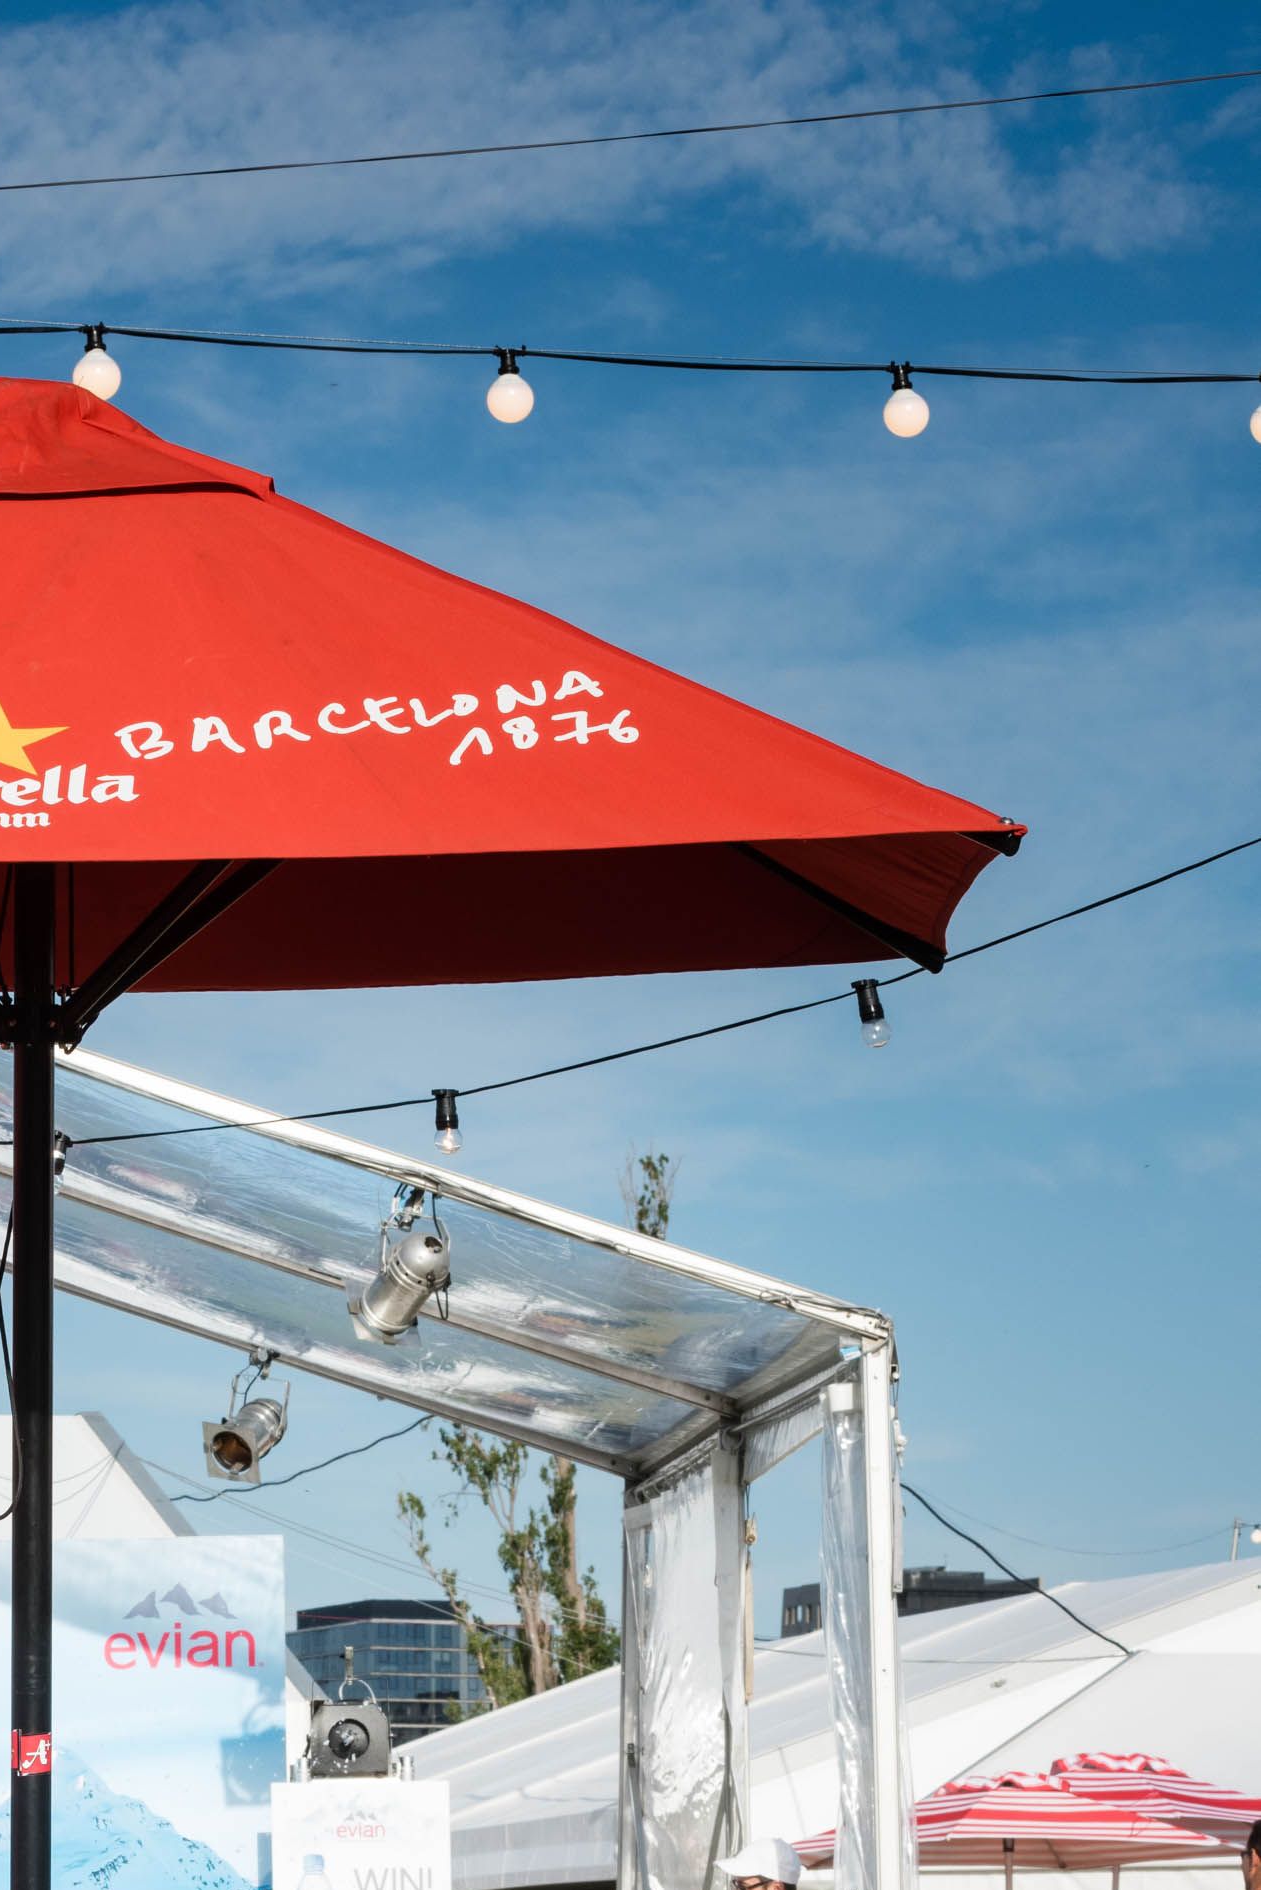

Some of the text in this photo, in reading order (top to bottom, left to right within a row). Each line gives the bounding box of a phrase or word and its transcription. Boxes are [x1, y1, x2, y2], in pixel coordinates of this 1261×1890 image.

[114, 669, 605, 760] BARCELONA
[449, 709, 641, 767] 1876
[104, 1621, 257, 1670] evian
[336, 1821, 386, 1839] evian
